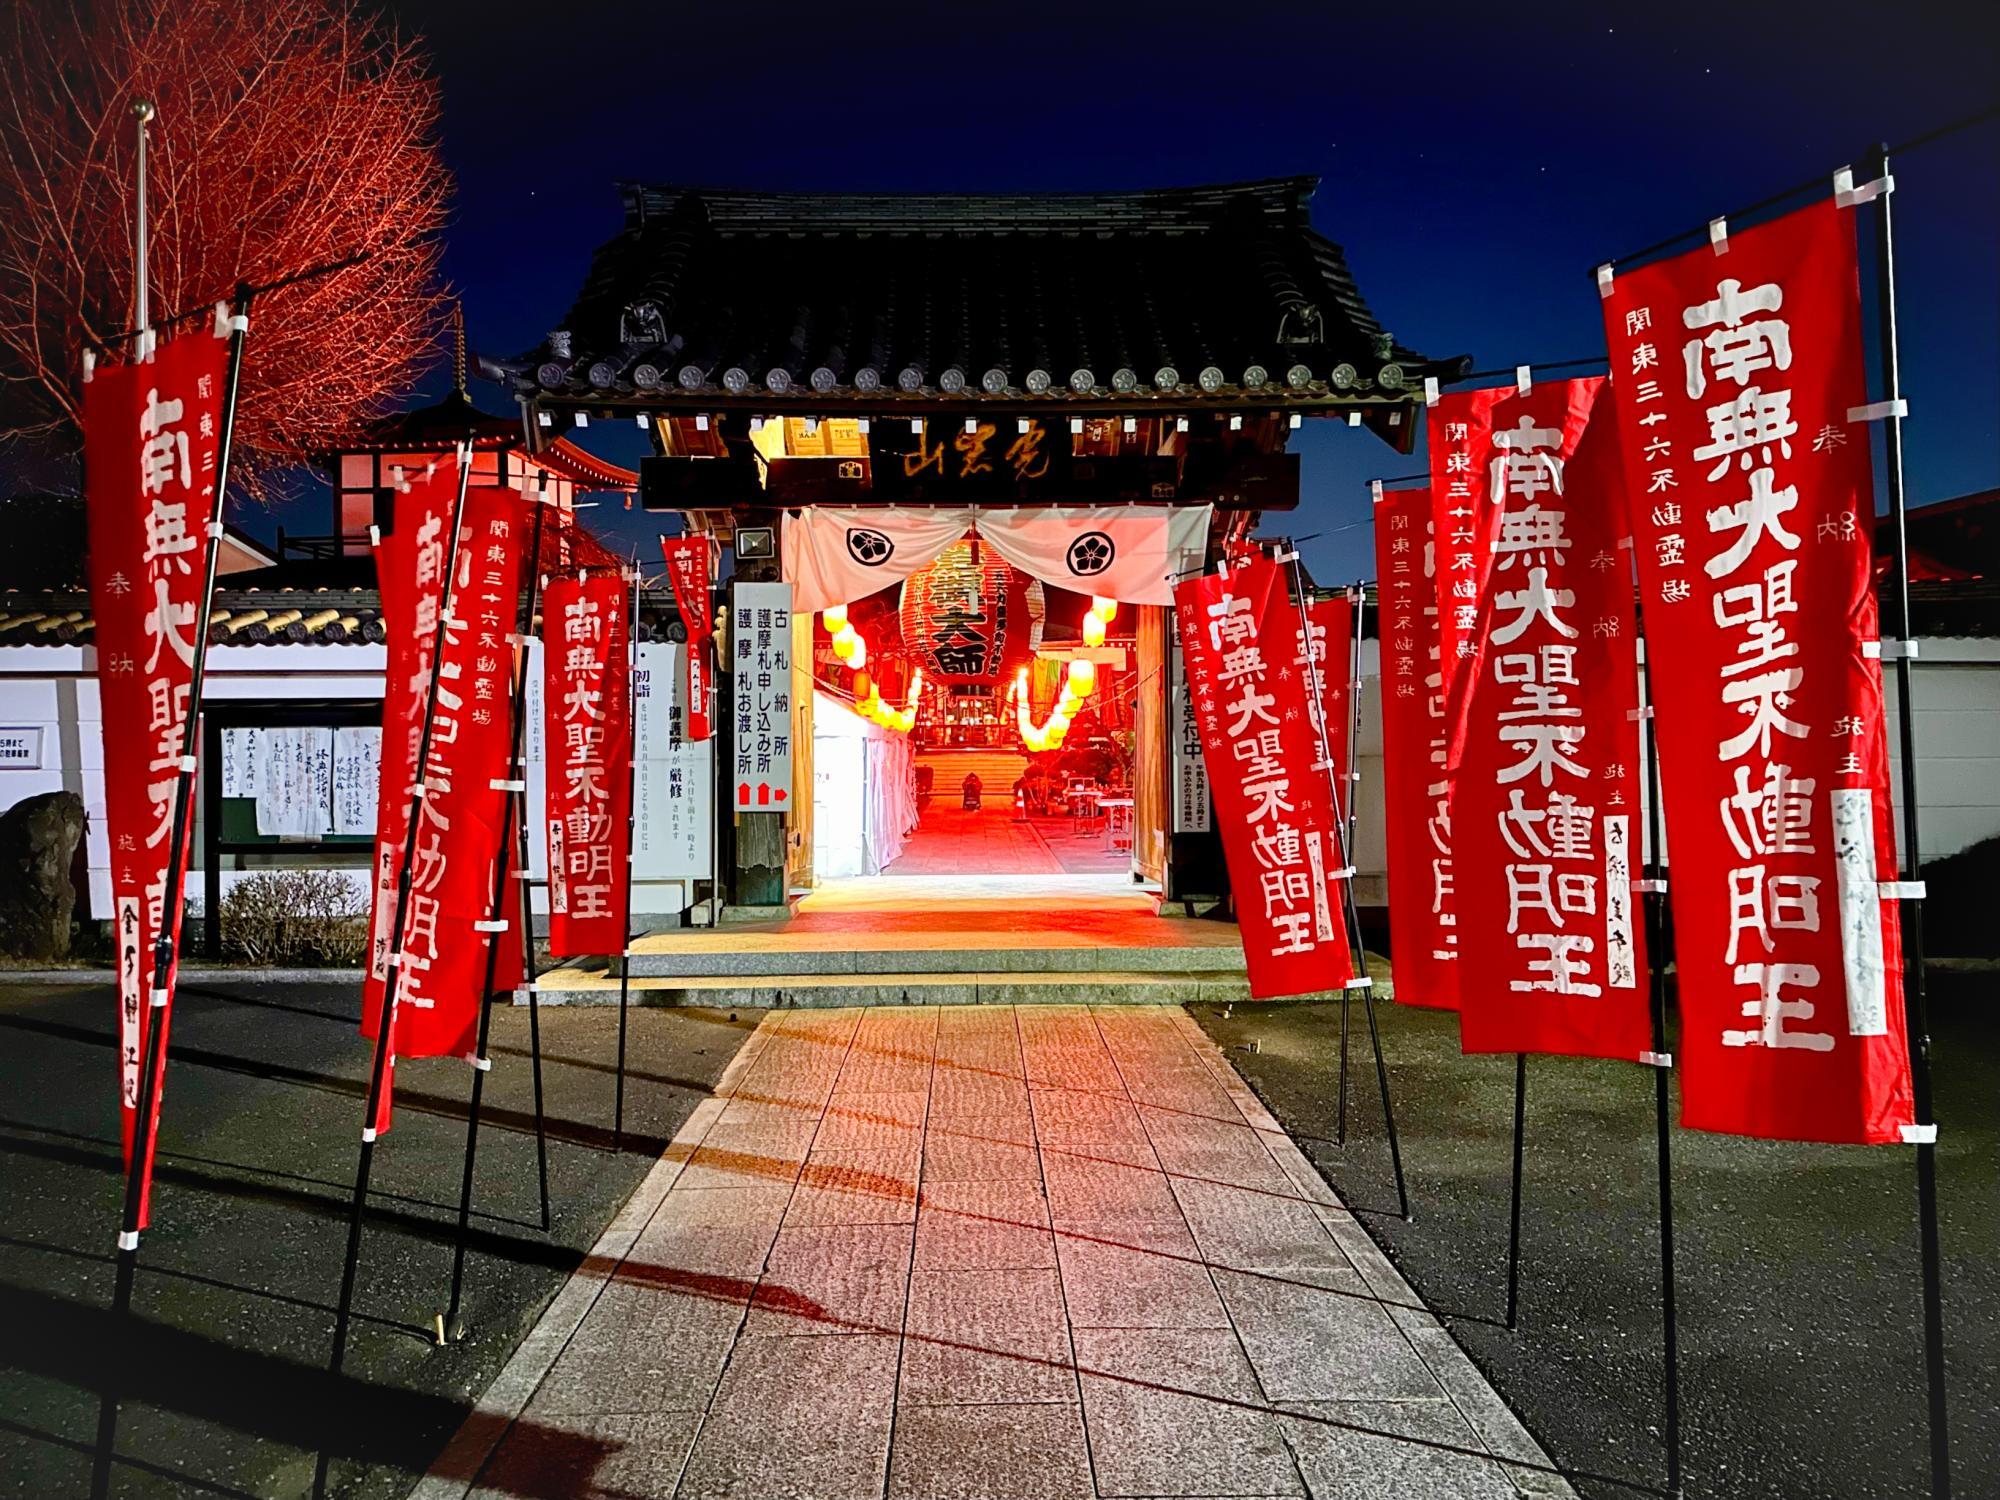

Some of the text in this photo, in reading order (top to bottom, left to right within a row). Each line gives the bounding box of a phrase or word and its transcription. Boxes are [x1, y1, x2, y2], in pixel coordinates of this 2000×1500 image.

[471, 519, 509, 726] 関東三十六不動霊場
[738, 608, 752, 775] 護摩札お渡し所
[757, 608, 772, 773] 護摩札申し込み所
[774, 608, 788, 757] 古札納所
[563, 596, 614, 920] 南無大聖不動明王
